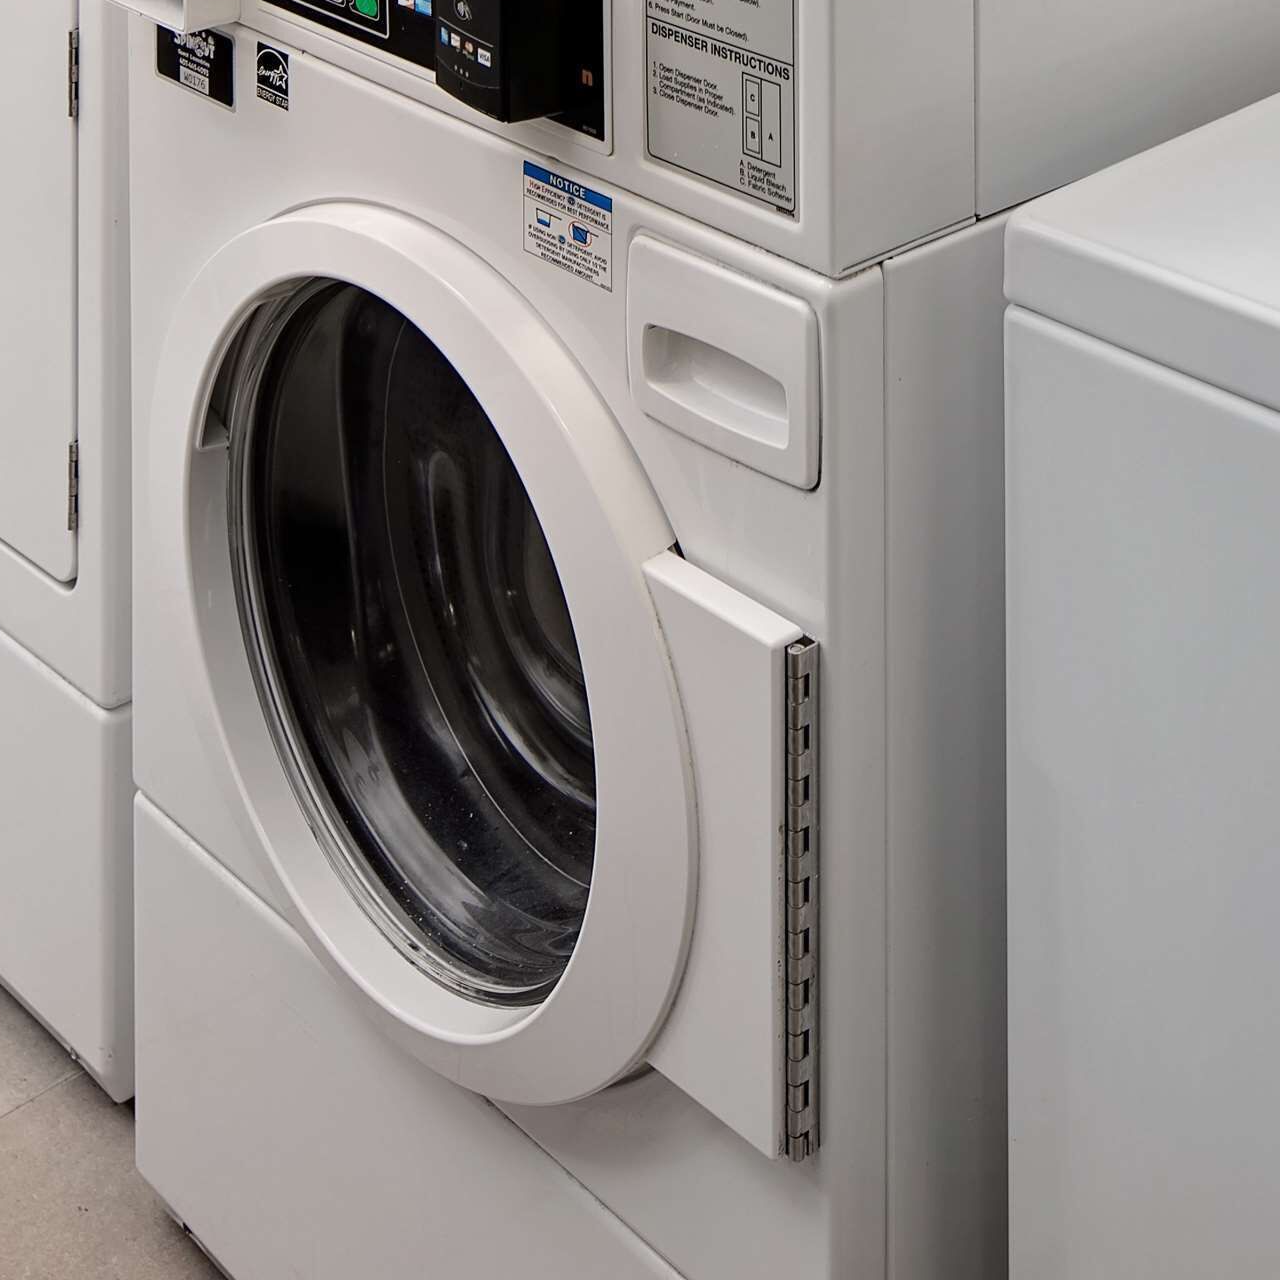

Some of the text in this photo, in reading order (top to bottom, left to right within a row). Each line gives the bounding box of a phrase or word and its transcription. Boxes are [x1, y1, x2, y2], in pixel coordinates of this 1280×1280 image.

[655, 3, 669, 15] Press
[671, 8, 684, 19] Start
[685, 13, 701, 25] (Door
[702, 18, 716, 29] Must
[717, 23, 724, 32] be
[651, 23, 790, 80] DISPENSER INSTRUCTIONS
[659, 63, 673, 75] Open
[675, 68, 702, 85] Dispenser
[257, 88, 288, 108] ENERGY STAR
[659, 73, 672, 82] Load
[674, 78, 697, 93] Supplies
[705, 88, 723, 101] Proper
[659, 81, 695, 101] Compartment
[697, 94, 705, 104] (as
[750, 93, 755, 102] C
[659, 90, 674, 101] Close
[676, 94, 703, 112] Dispenser
[751, 131, 755, 139] B
[768, 133, 773, 141] A
[740, 160, 776, 180] A. Detergent
[740, 168, 786, 192] B. Liquid Bleach
[549, 174, 586, 199] NOTICE
[740, 177, 792, 204] C. Fabric Softener
[557, 202, 566, 211] FOR
[567, 206, 577, 216] BEST
[576, 201, 601, 220] DETERGENT
